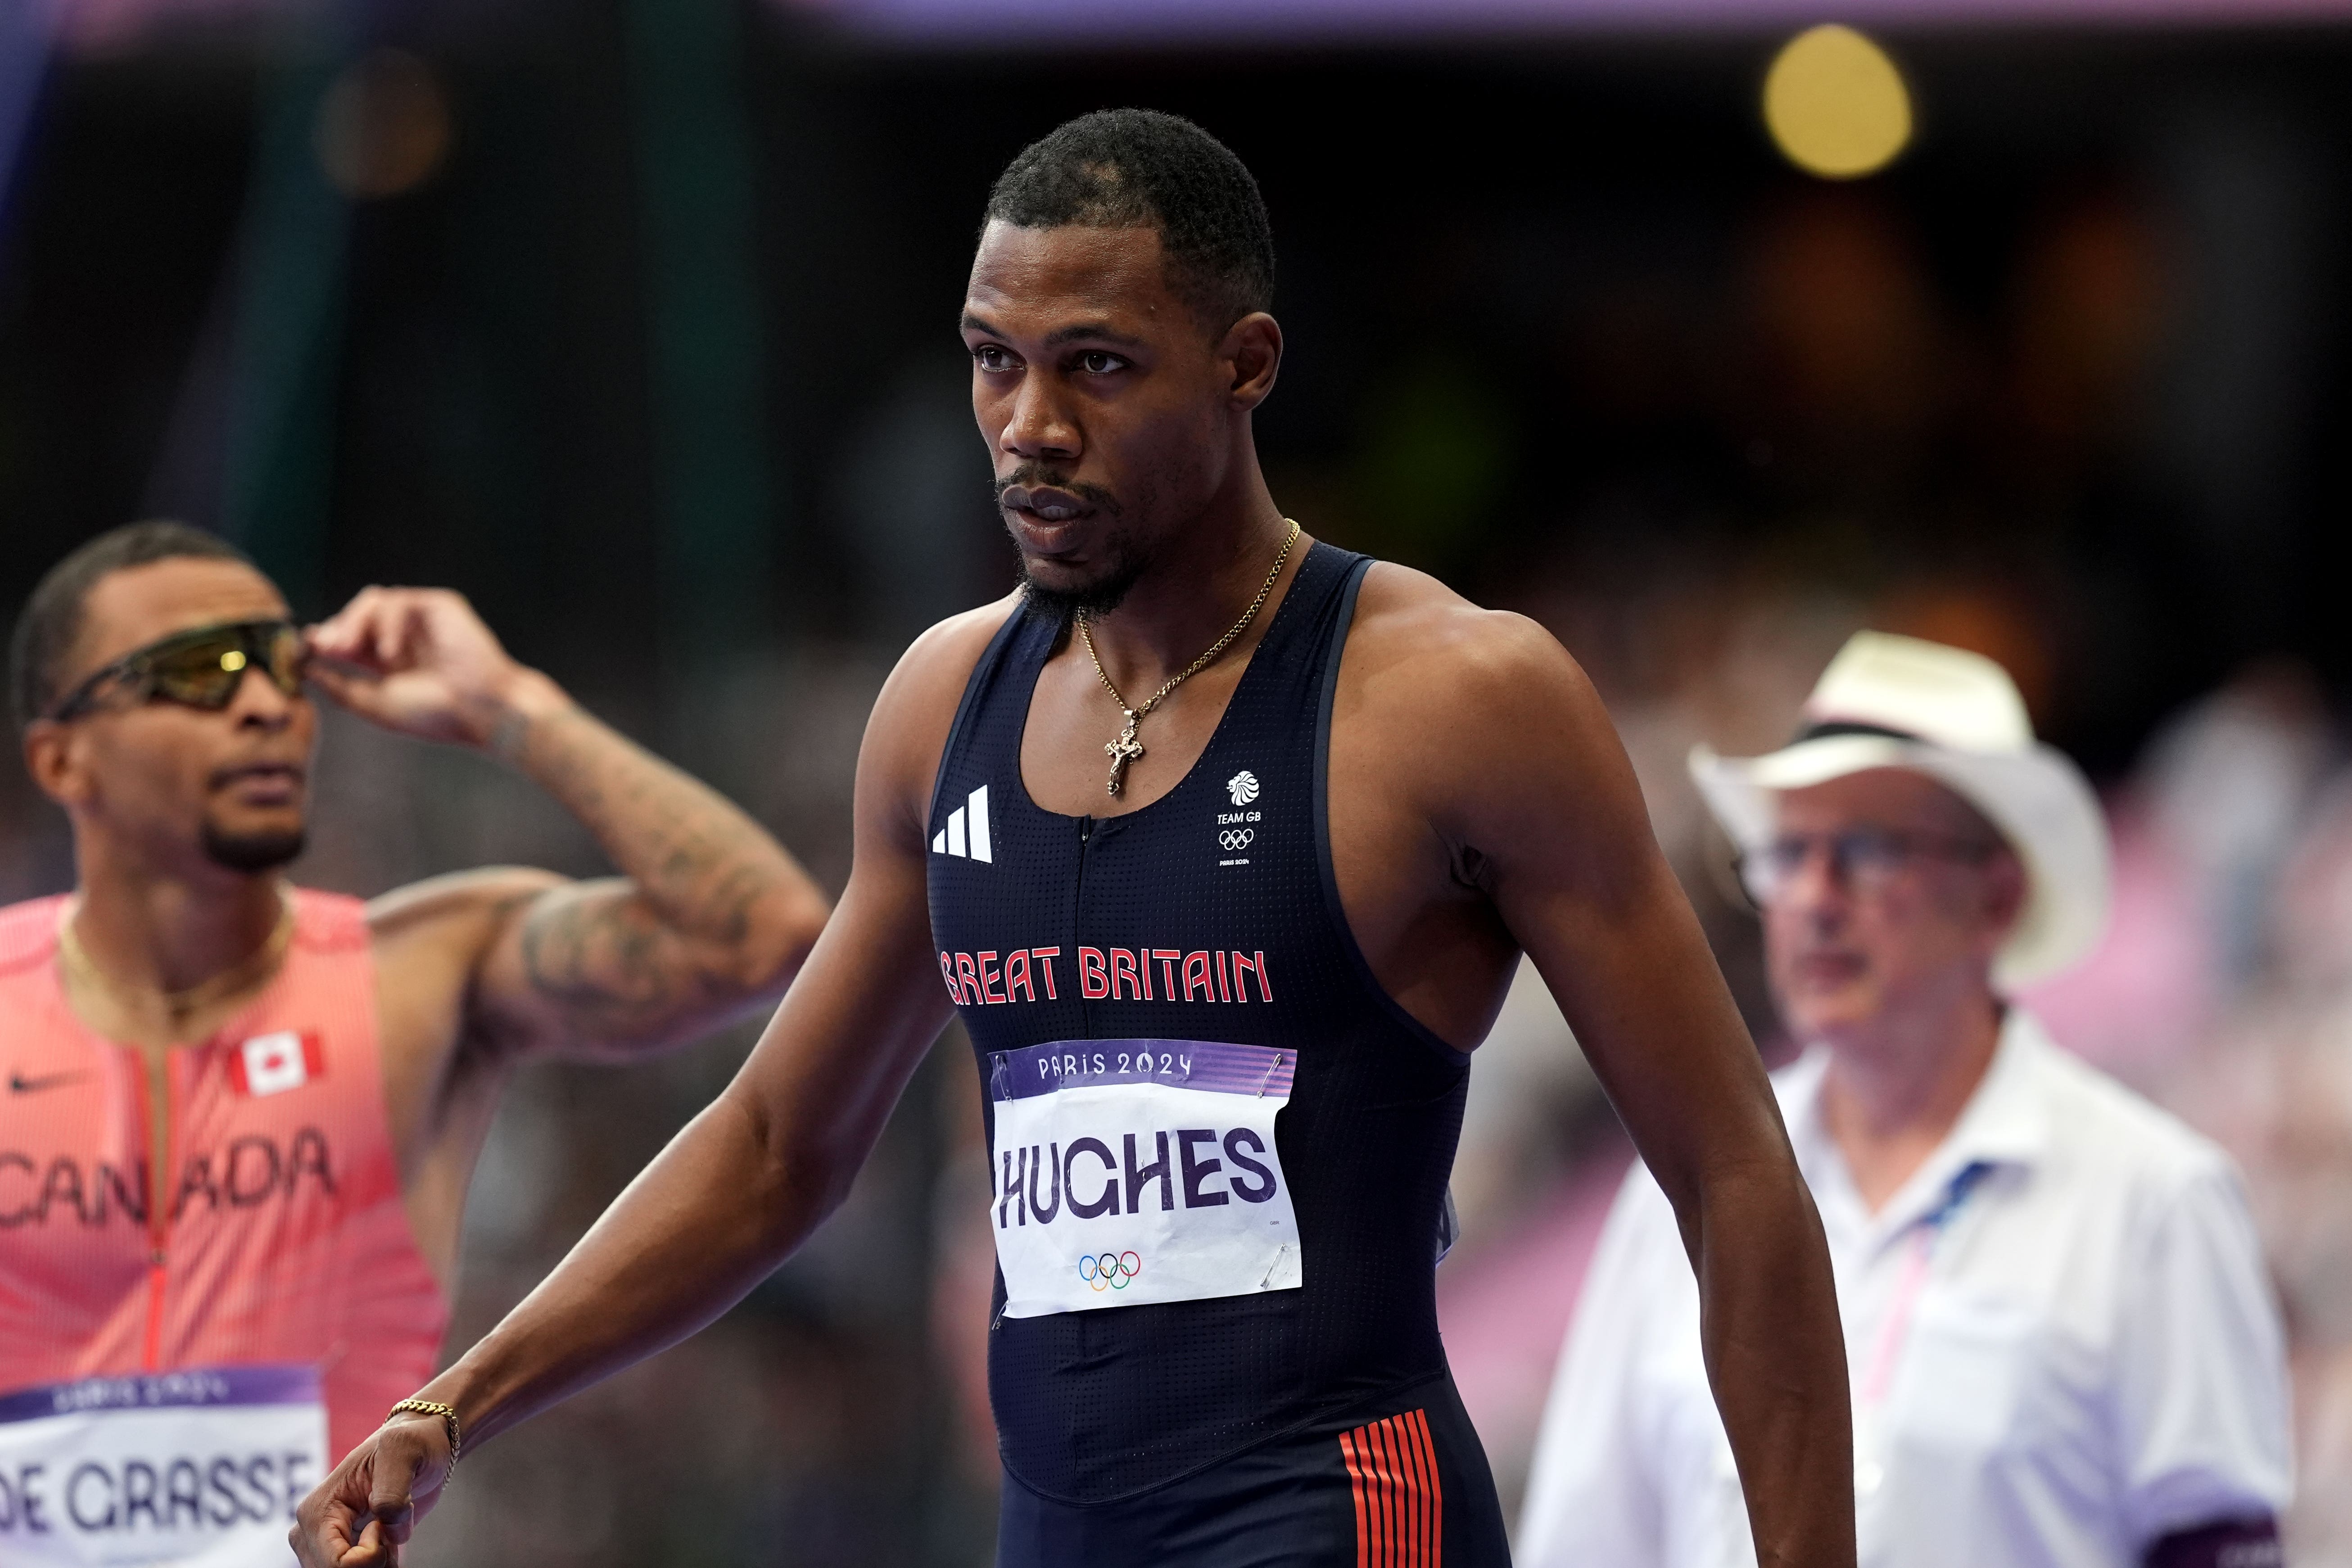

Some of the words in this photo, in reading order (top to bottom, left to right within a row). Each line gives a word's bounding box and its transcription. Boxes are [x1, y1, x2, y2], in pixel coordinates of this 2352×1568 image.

[1217, 812, 1244, 824] TEAM
[1246, 811, 1261, 822] GB
[941, 946, 1060, 1005] GREAT
[1078, 946, 1273, 1003] BRITAIN
[1117, 1053, 1191, 1075] 2024
[0, 1126, 338, 1228] CANADA
[1000, 1127, 1277, 1229] HUGHES
